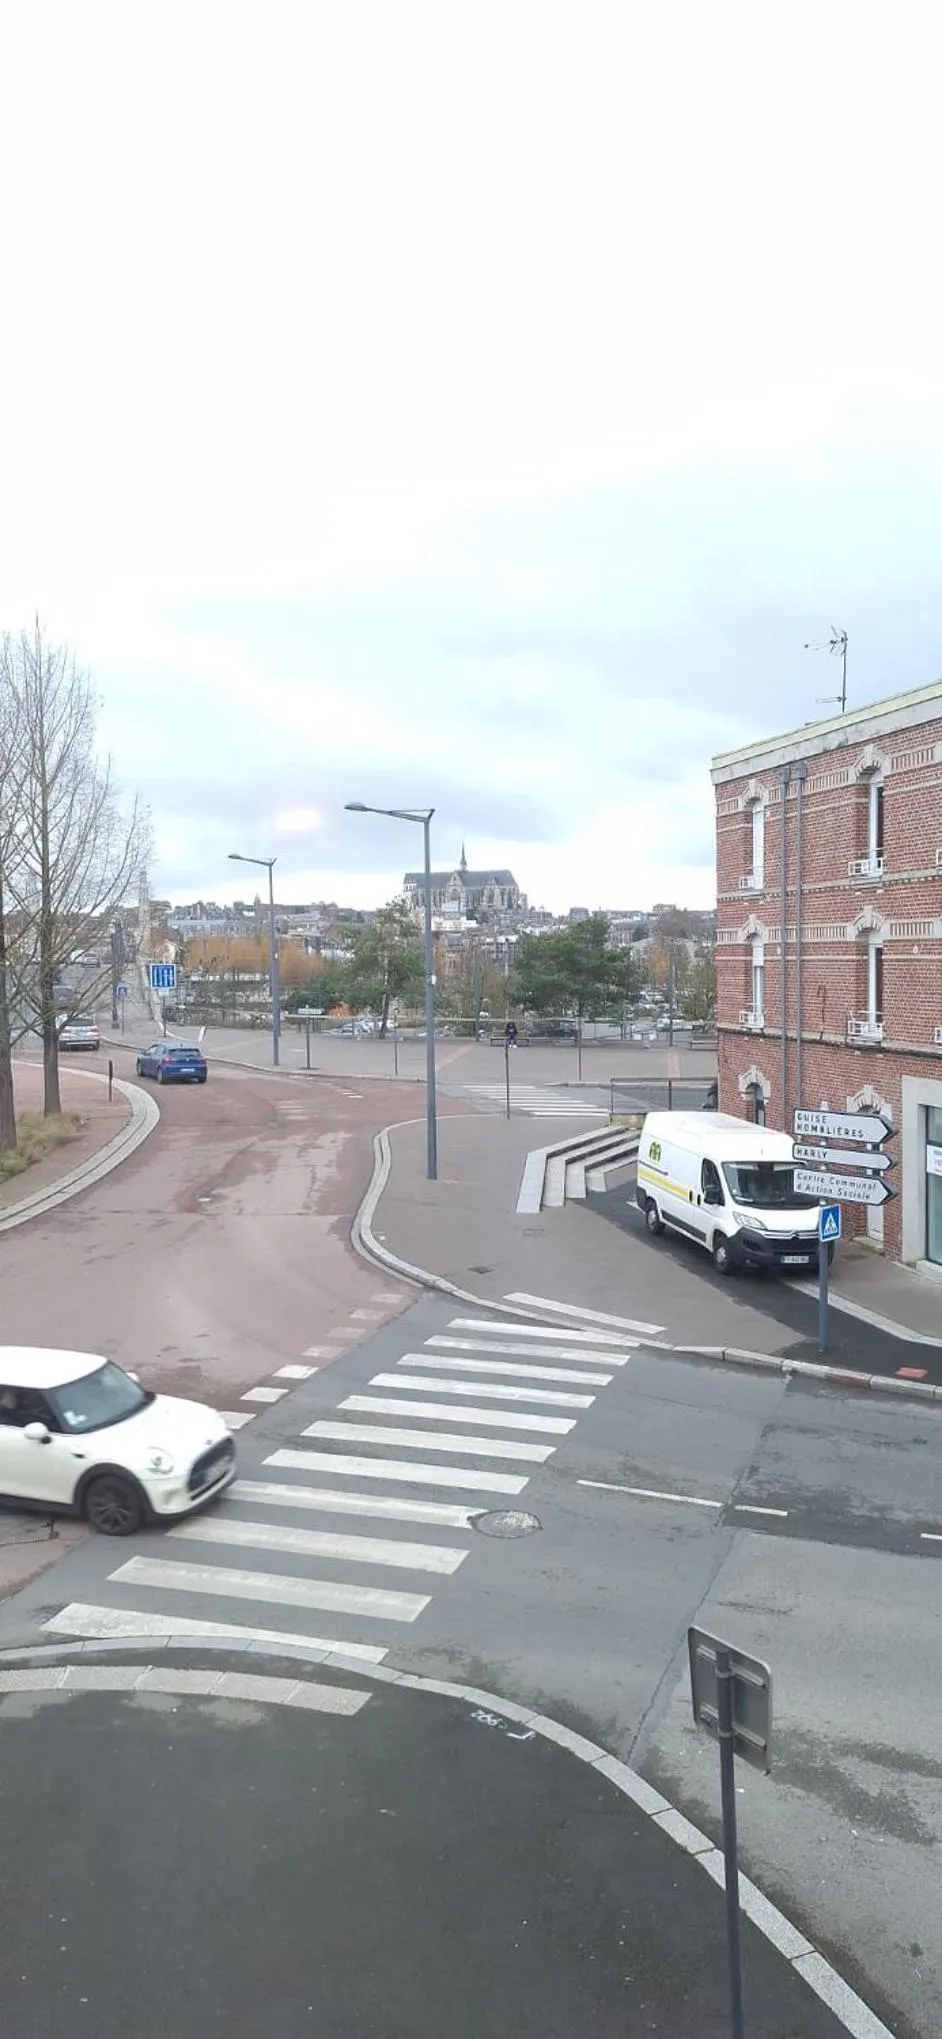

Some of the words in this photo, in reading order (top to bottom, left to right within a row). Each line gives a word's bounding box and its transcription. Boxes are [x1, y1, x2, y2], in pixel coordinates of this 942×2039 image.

[797, 1113, 827, 1124] GUISE
[797, 1123, 864, 1138] HOMBLIÈRES
[796, 1148, 828, 1159] HARLY
[797, 1172, 825, 1184] Centre
[829, 1176, 876, 1191] Communal
[837, 1188, 871, 1200] Sociale
